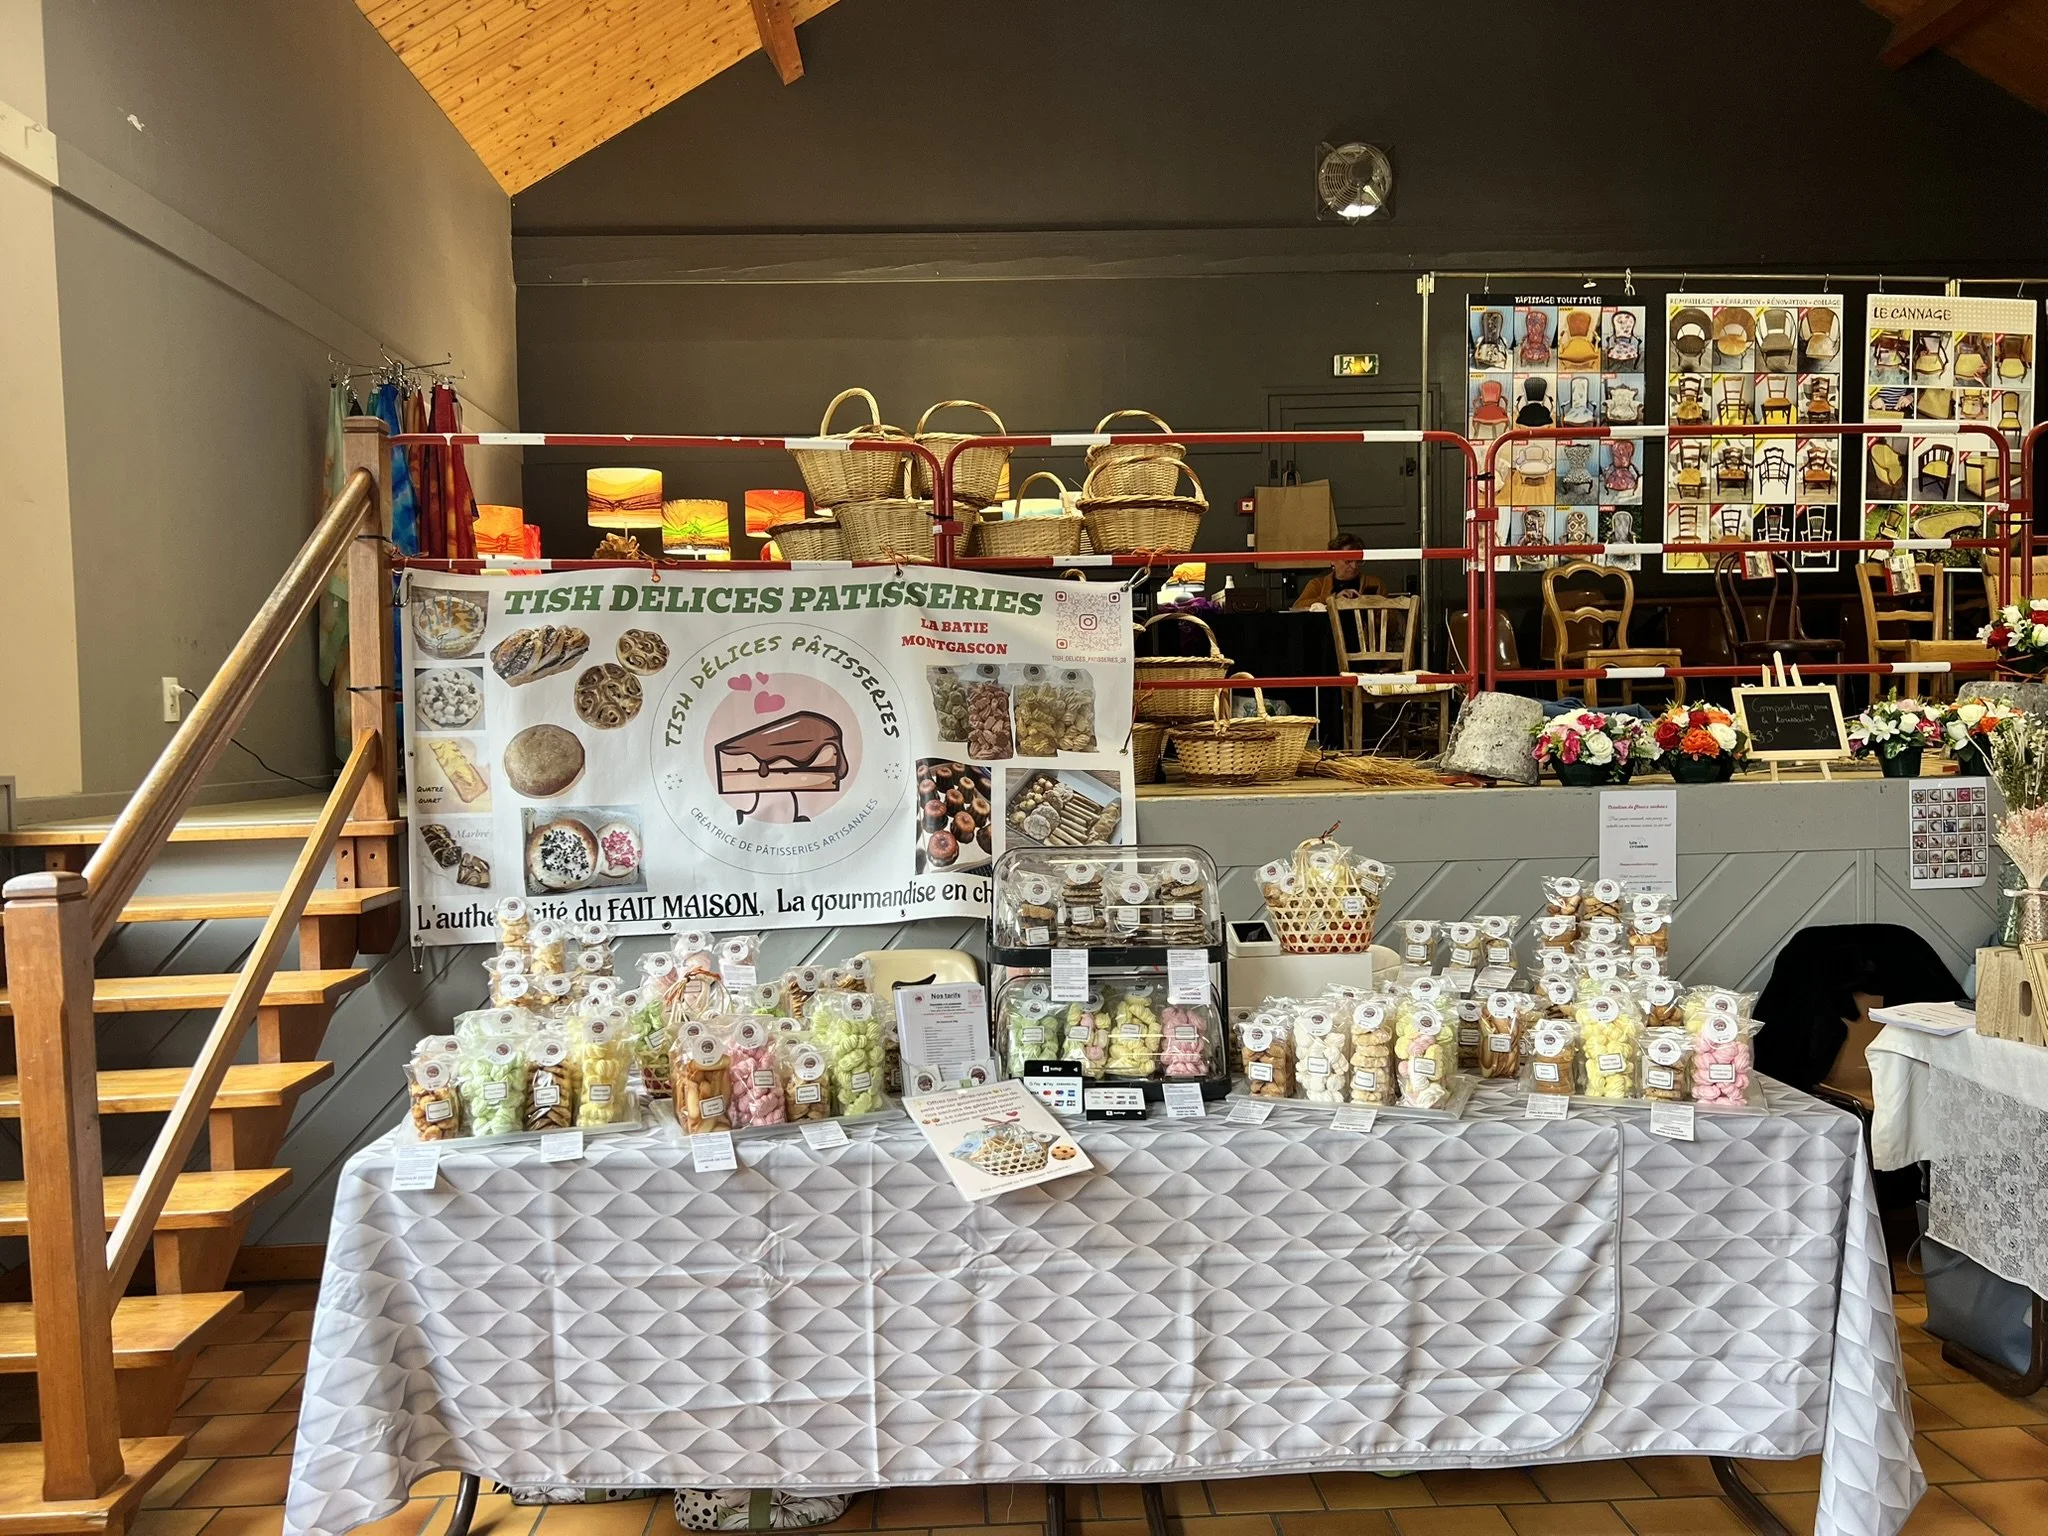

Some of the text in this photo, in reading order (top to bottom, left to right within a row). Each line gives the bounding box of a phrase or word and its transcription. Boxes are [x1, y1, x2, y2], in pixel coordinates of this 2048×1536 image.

[1514, 296, 1602, 304] TAPISSAGE TOUT STYLE
[1873, 306, 1952, 321] LE CANNAGE
[504, 581, 1044, 616] TISH DELICES PATISSERIES
[920, 618, 988, 634] LA BATIE
[901, 635, 1008, 655] MONTGASCON
[666, 634, 900, 746] TISH DÉLICES PÂTISSERIES
[1751, 697, 1810, 716] Composition
[690, 798, 878, 856] CRÉATRICE DE PÂTISSERIES ARTISANALES
[575, 899, 600, 922] du
[607, 895, 656, 922] FAIT
[664, 891, 764, 919] MAISON,
[776, 888, 805, 912] La
[811, 880, 936, 922] gourmandise
[942, 883, 967, 901] en
